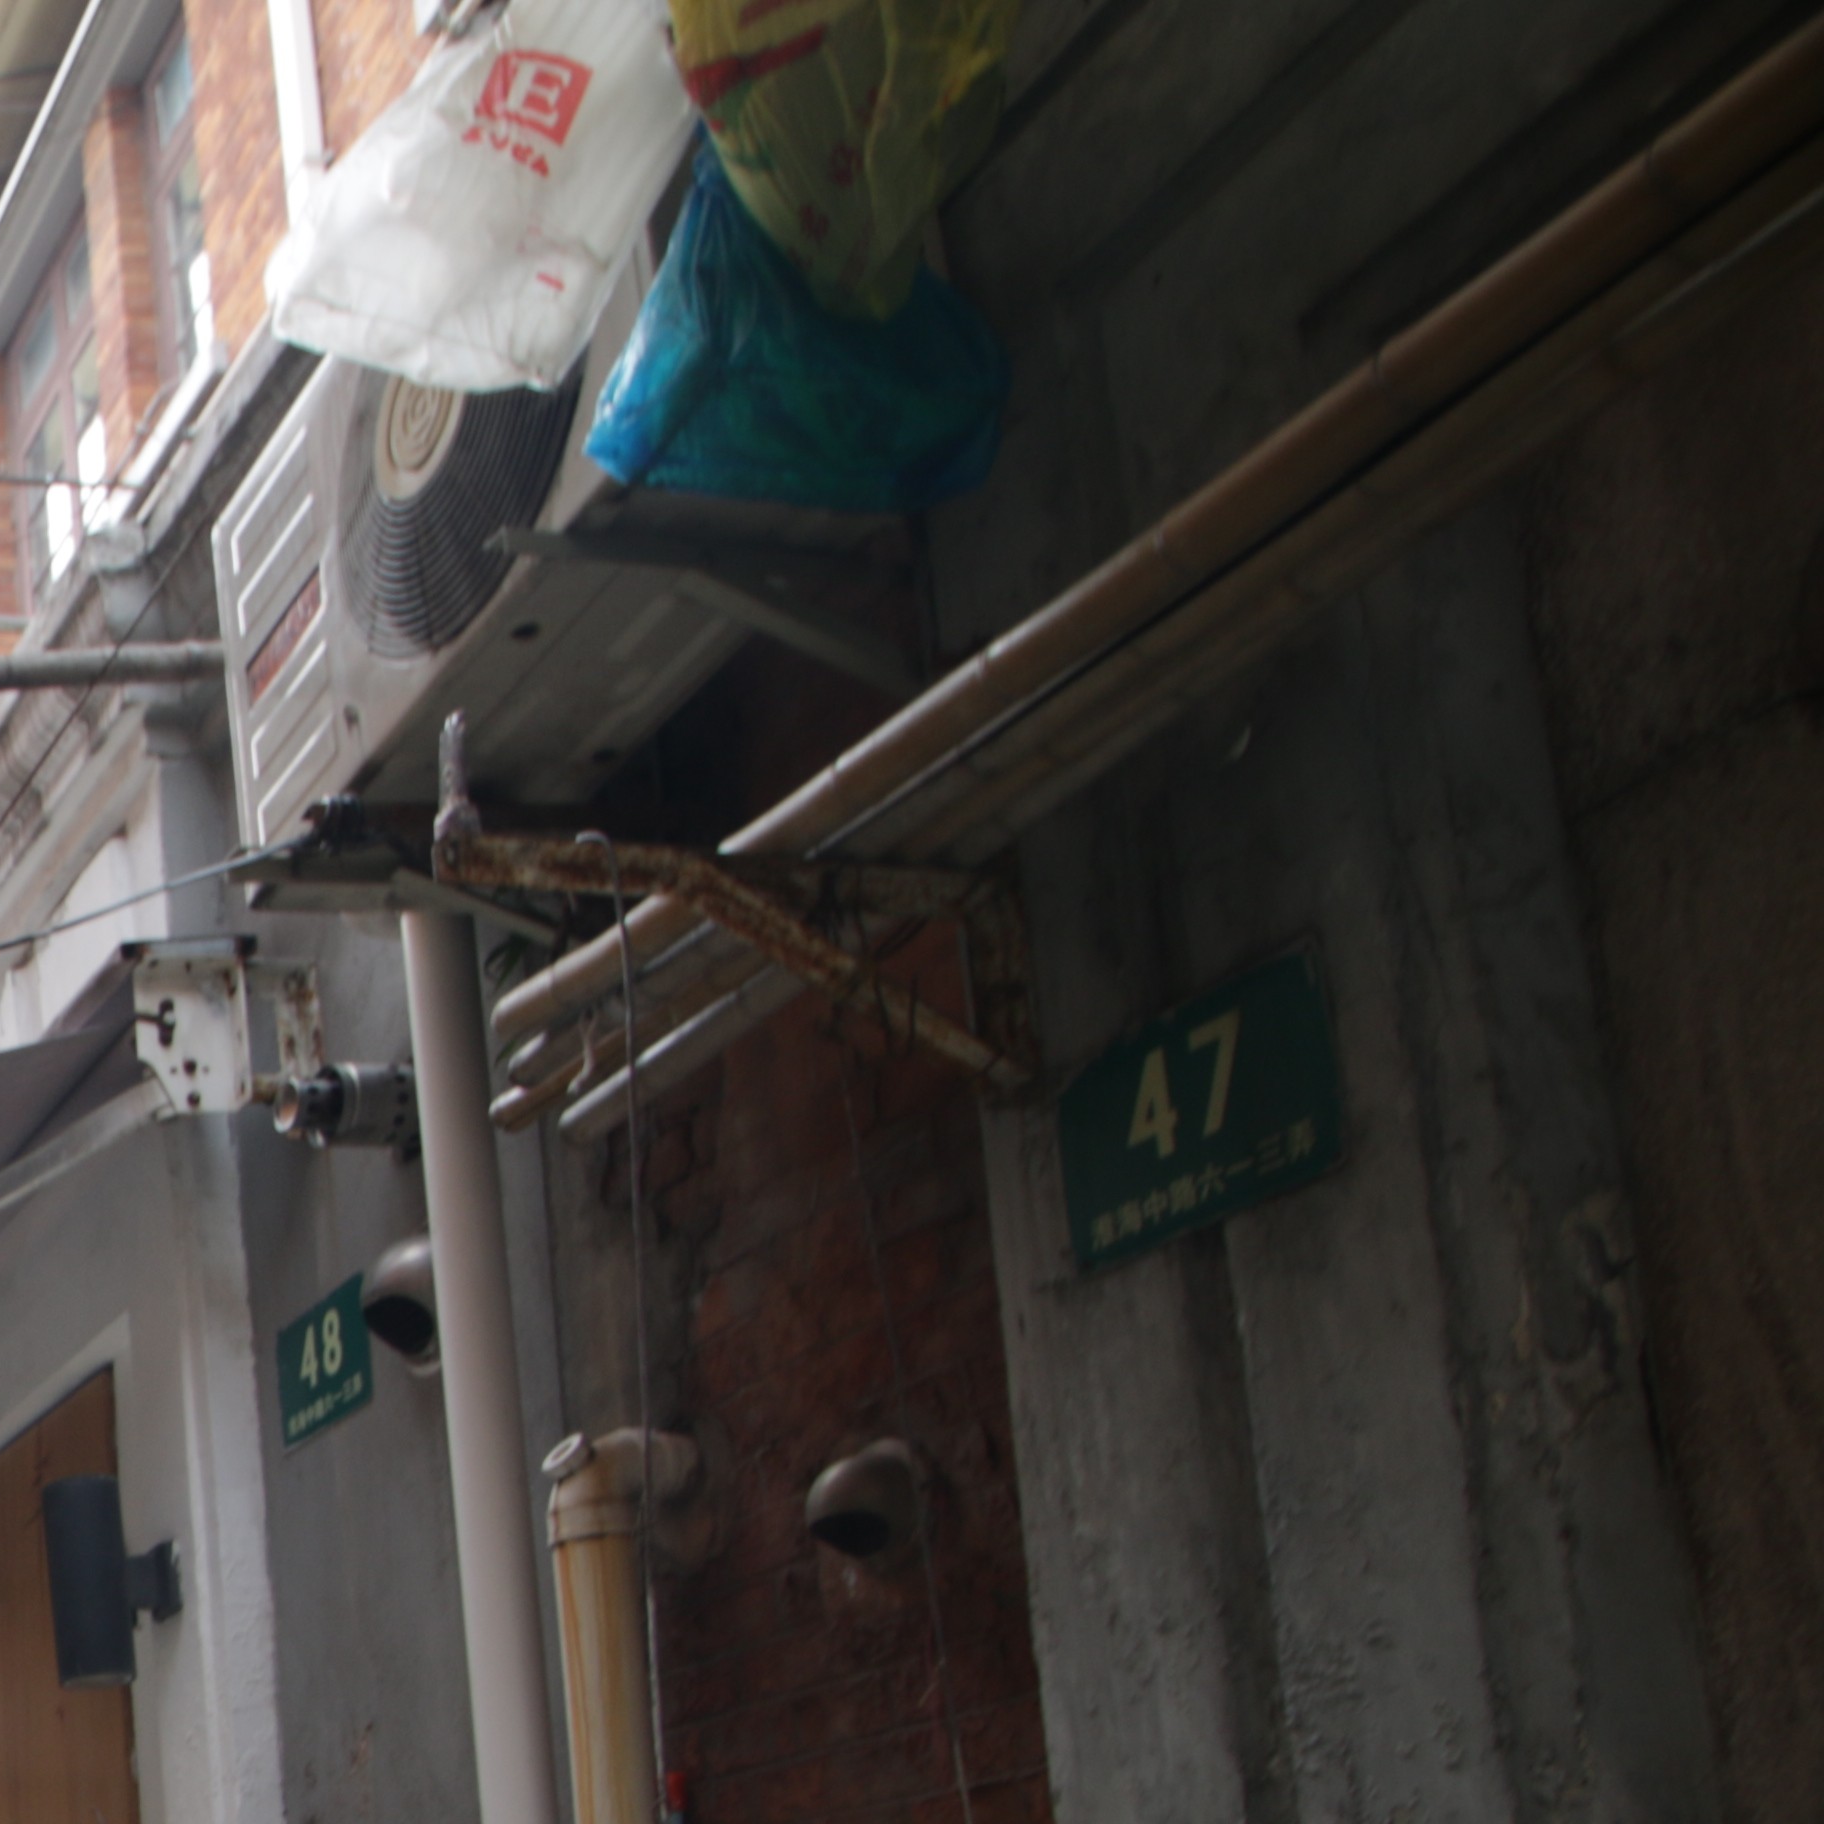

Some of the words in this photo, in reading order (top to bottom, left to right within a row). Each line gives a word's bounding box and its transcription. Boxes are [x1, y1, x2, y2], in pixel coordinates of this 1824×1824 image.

[1127, 1006, 1241, 1160] 47
[1091, 1117, 1317, 1251] 淮海中路六一三弄
[299, 1307, 343, 1388] 48
